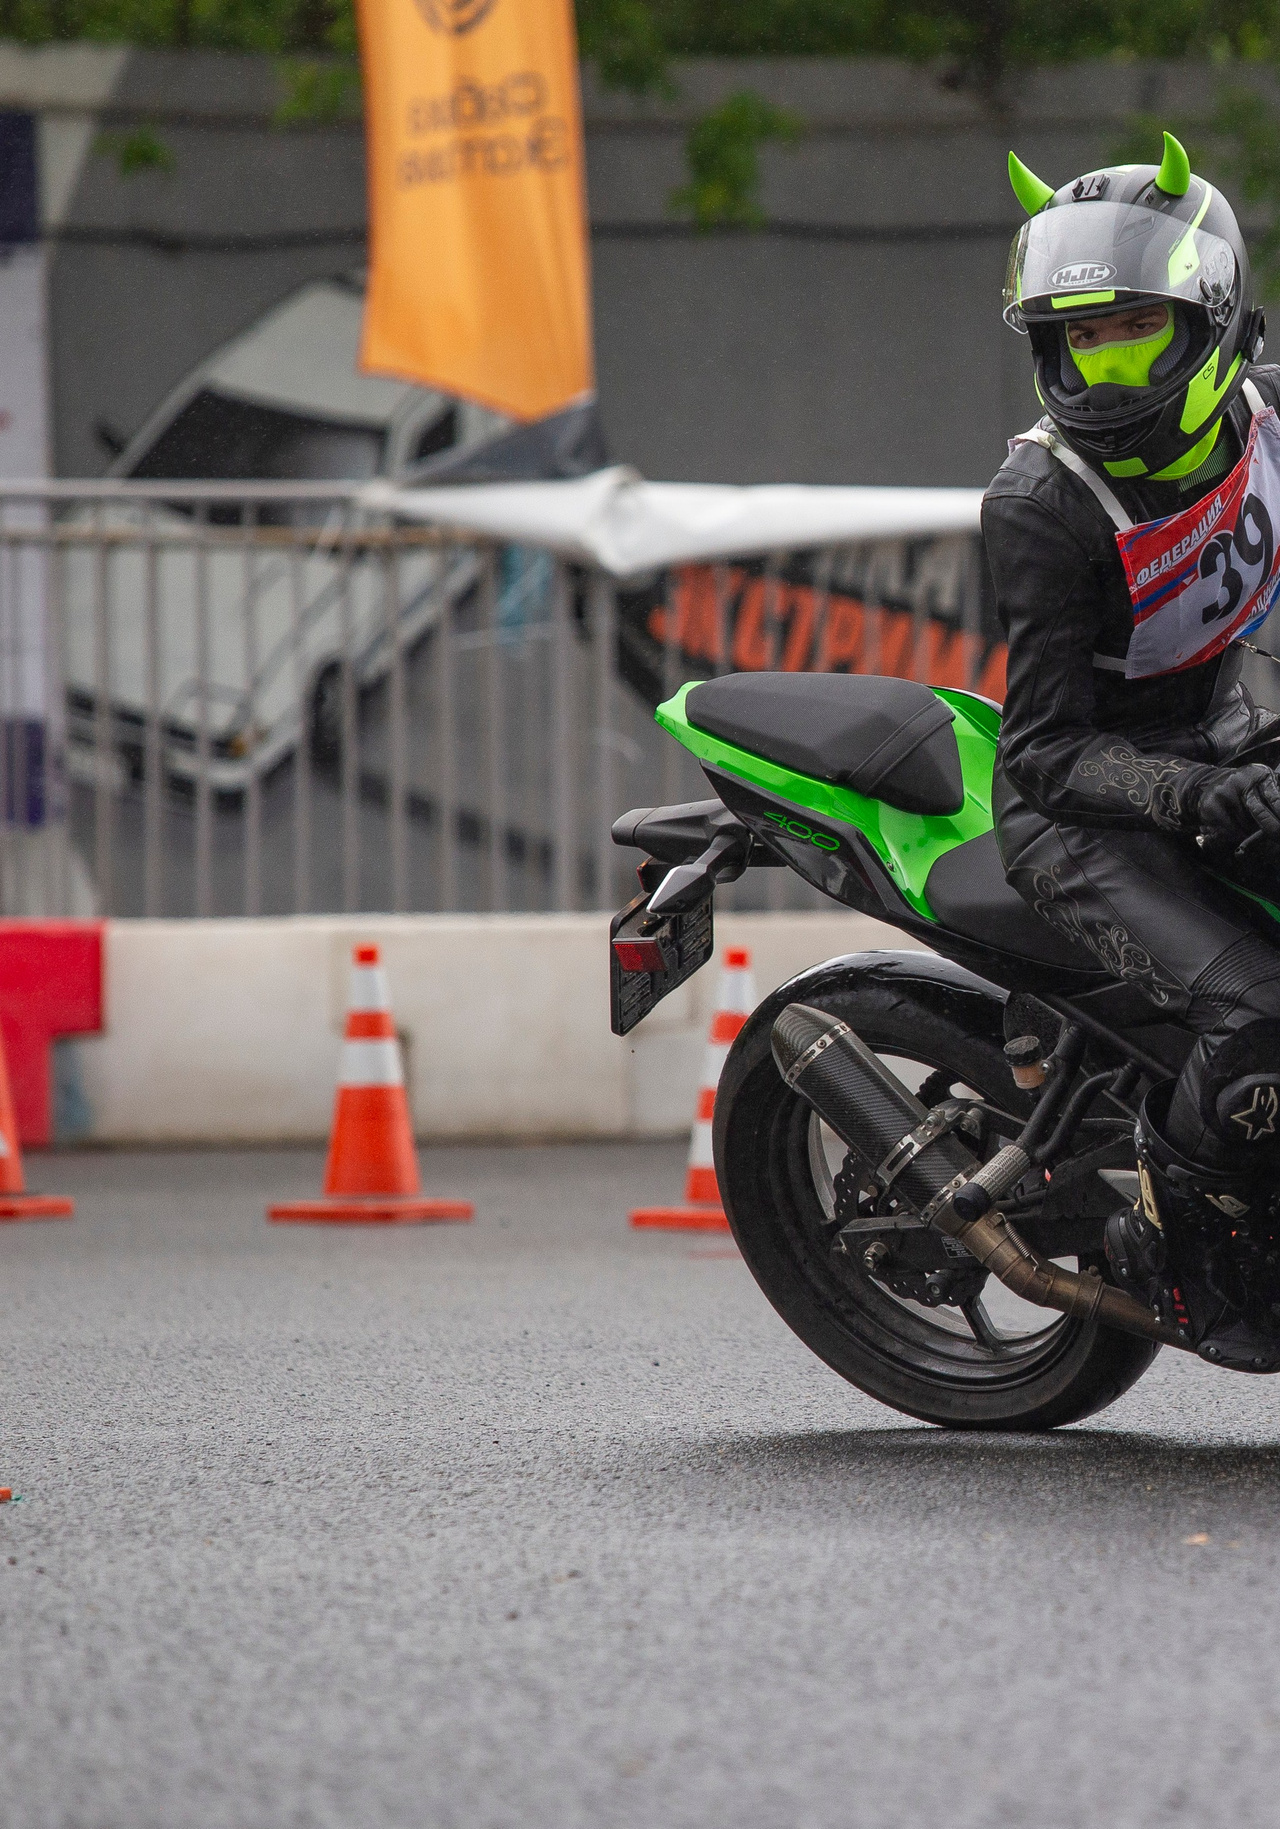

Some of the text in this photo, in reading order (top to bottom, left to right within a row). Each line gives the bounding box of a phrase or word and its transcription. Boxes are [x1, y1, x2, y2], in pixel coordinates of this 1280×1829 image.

[1055, 265, 1107, 284] HJC
[1136, 494, 1222, 587] ФЕДЕРАЦИЯ
[1198, 493, 1274, 625] 39
[764, 811, 840, 851] 400
